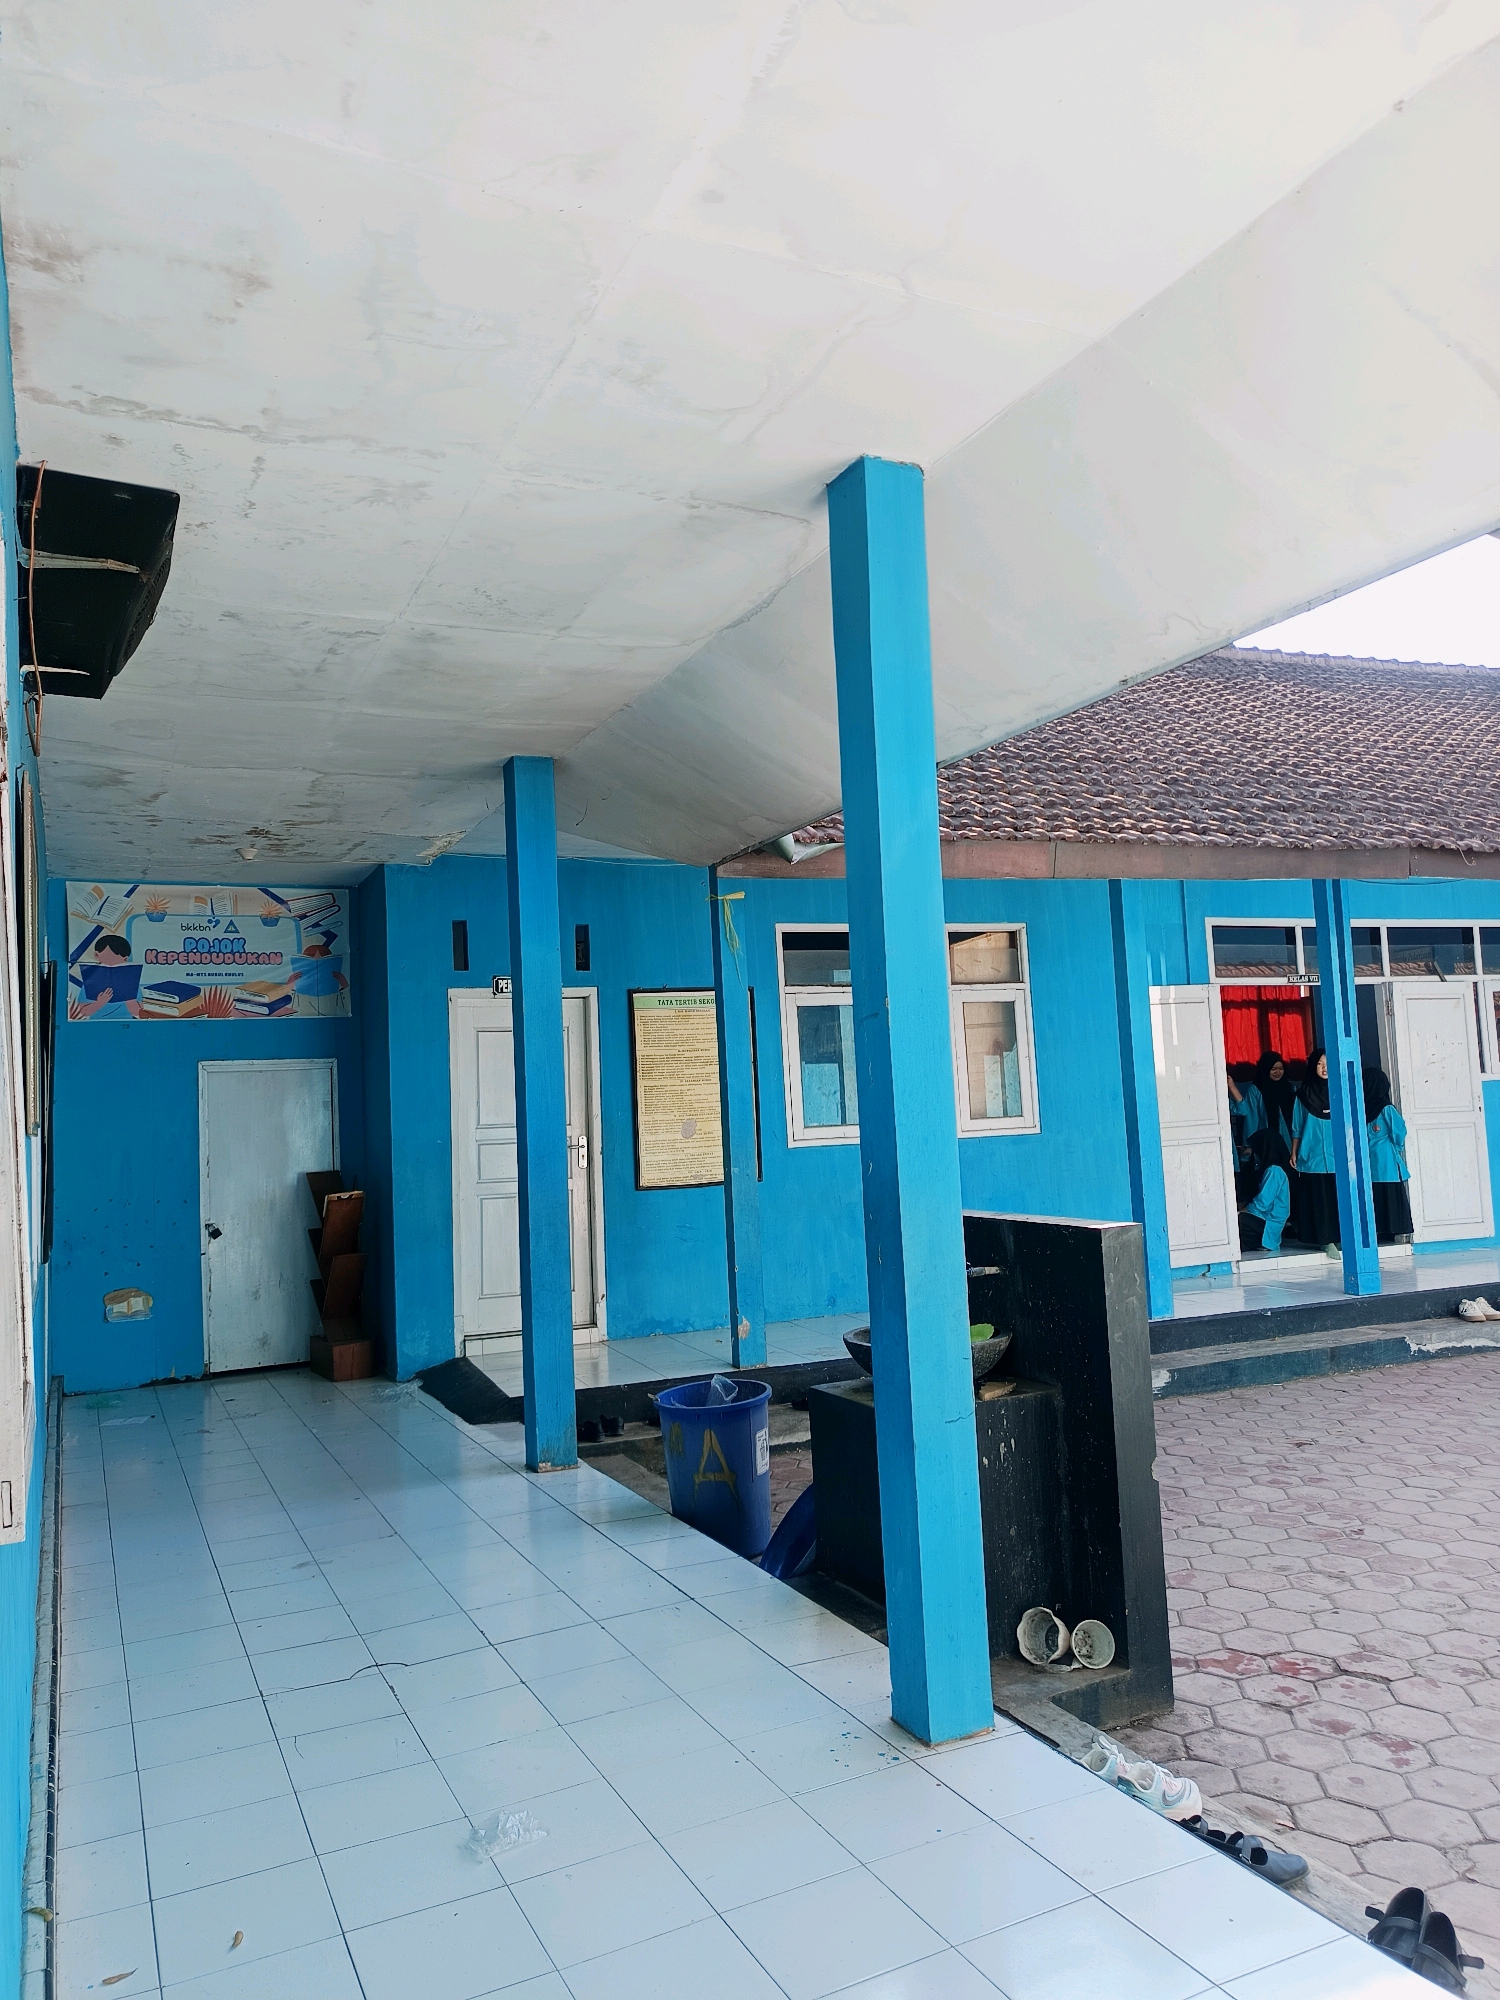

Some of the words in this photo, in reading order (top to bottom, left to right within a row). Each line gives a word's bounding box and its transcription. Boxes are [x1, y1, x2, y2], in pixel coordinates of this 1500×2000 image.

[181, 923, 211, 932] bkkbn
[183, 937, 246, 953] POJOK
[145, 949, 283, 965] KEPENDUDUKAN
